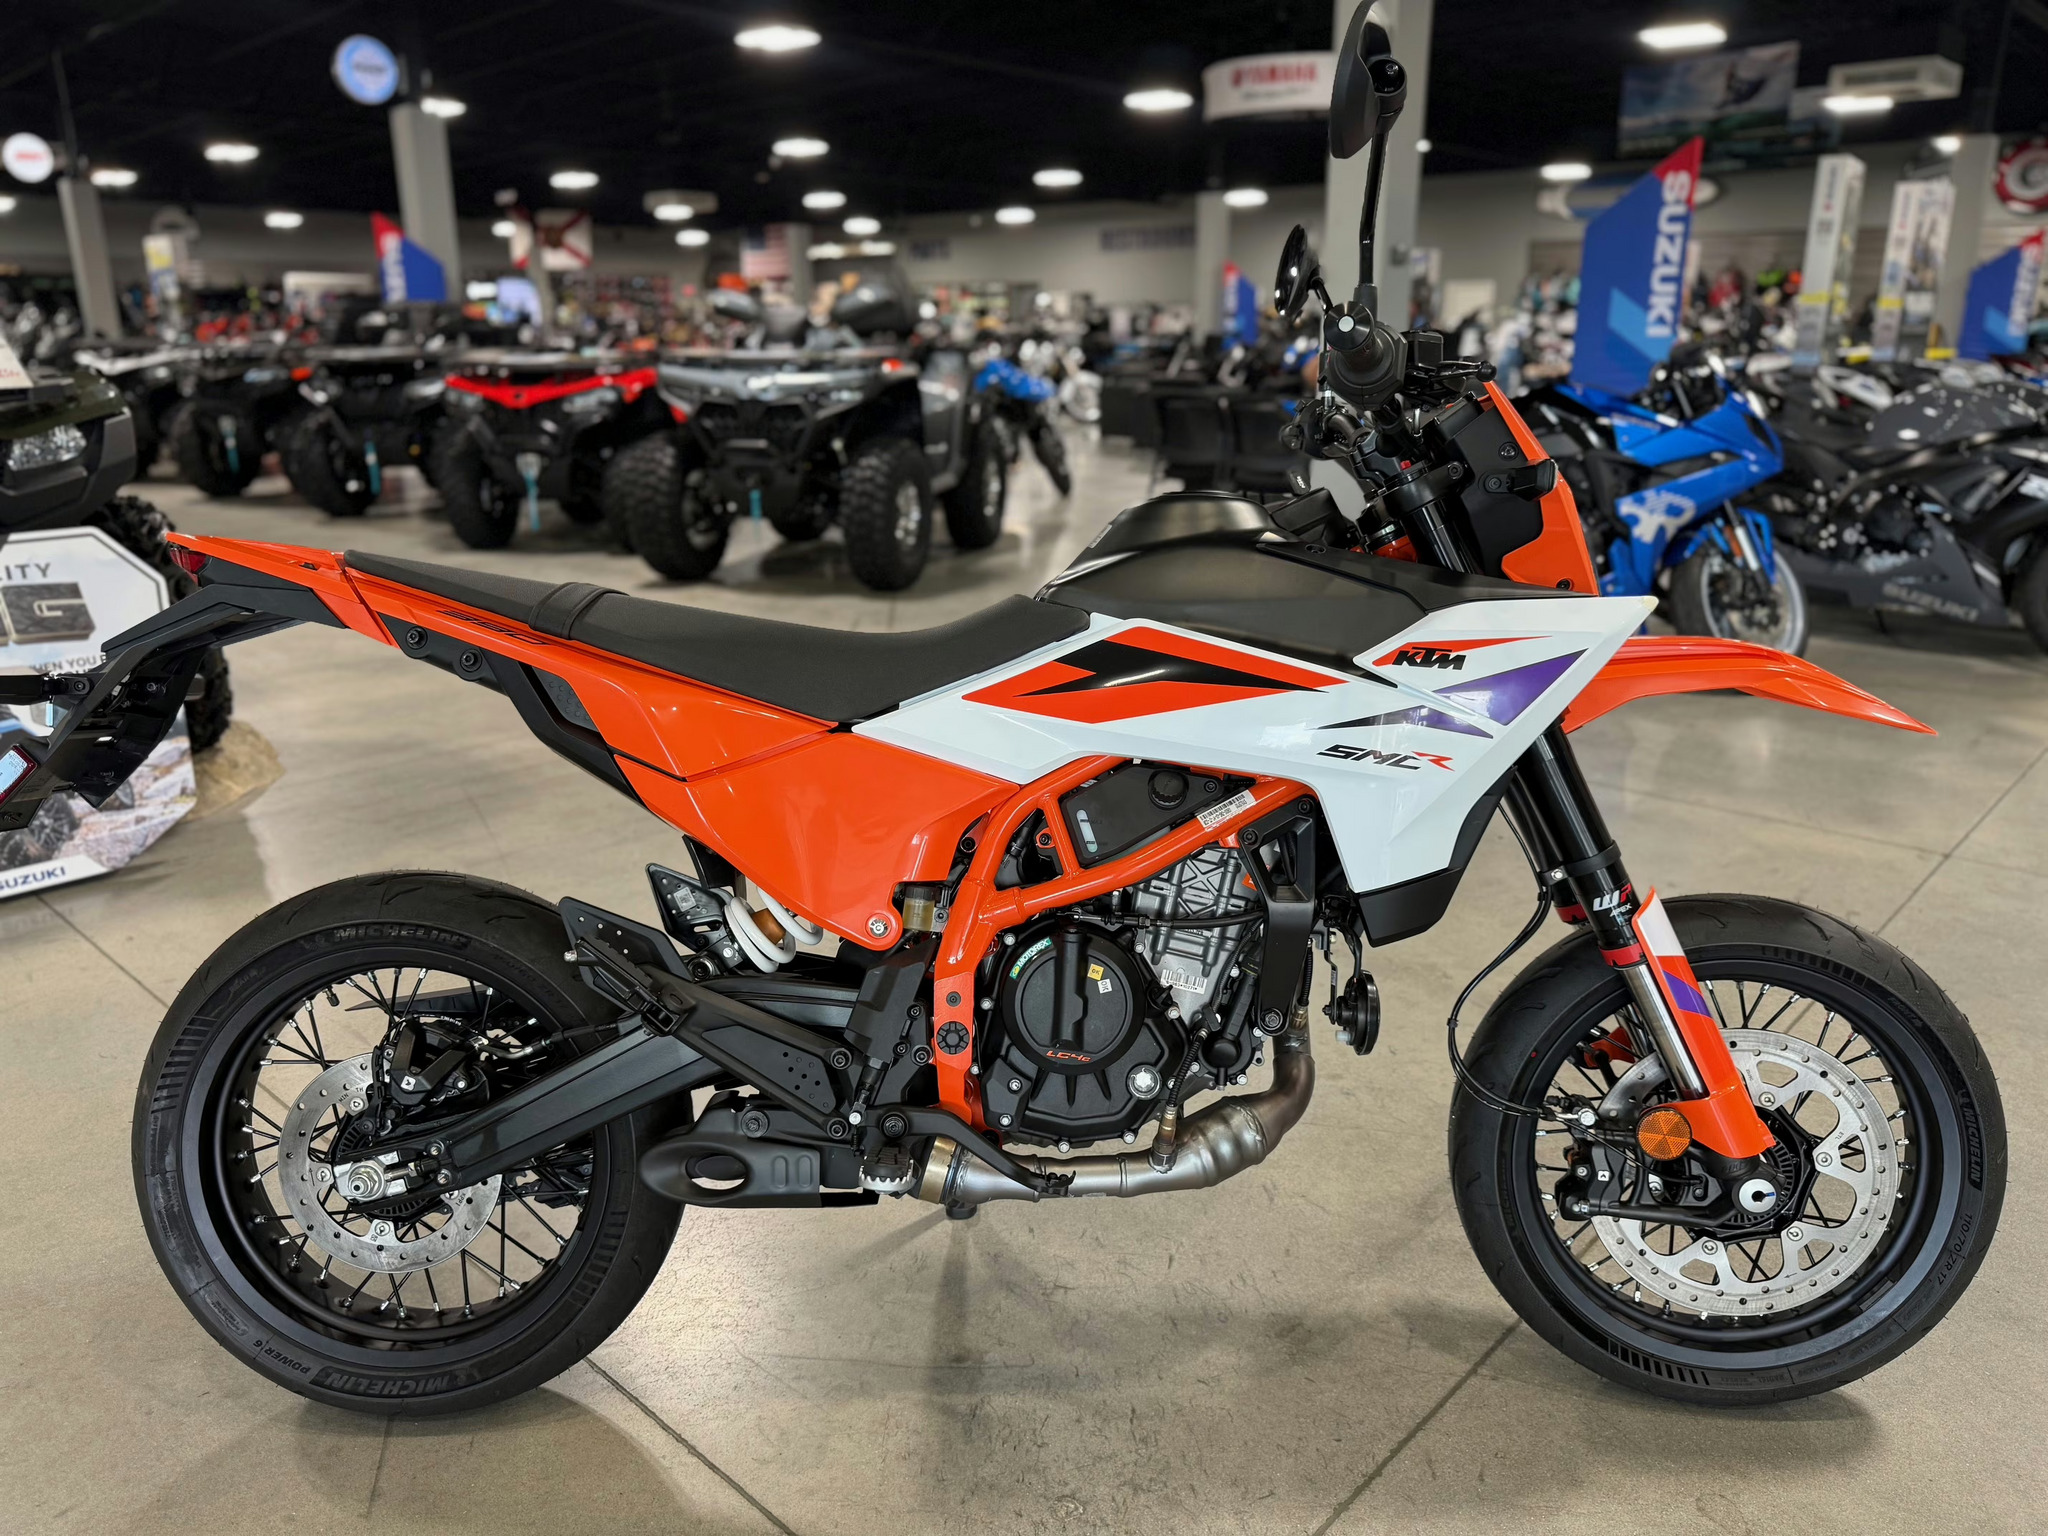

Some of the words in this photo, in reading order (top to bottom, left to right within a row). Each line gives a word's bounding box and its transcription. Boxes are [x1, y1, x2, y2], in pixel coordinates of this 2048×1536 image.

[1645, 169, 1692, 338] SUZUKI
[0, 562, 51, 581] ITY
[1392, 646, 1466, 670] KTM
[1101, 980, 1109, 991] OK
[1963, 1107, 1981, 1183] MICHELIN
[1954, 1212, 1973, 1253] 110/70
[1937, 1272, 1949, 1286] 17
[252, 1338, 263, 1348] 6
[264, 1346, 311, 1375] POWER
[324, 1375, 450, 1396] MICHELIN
